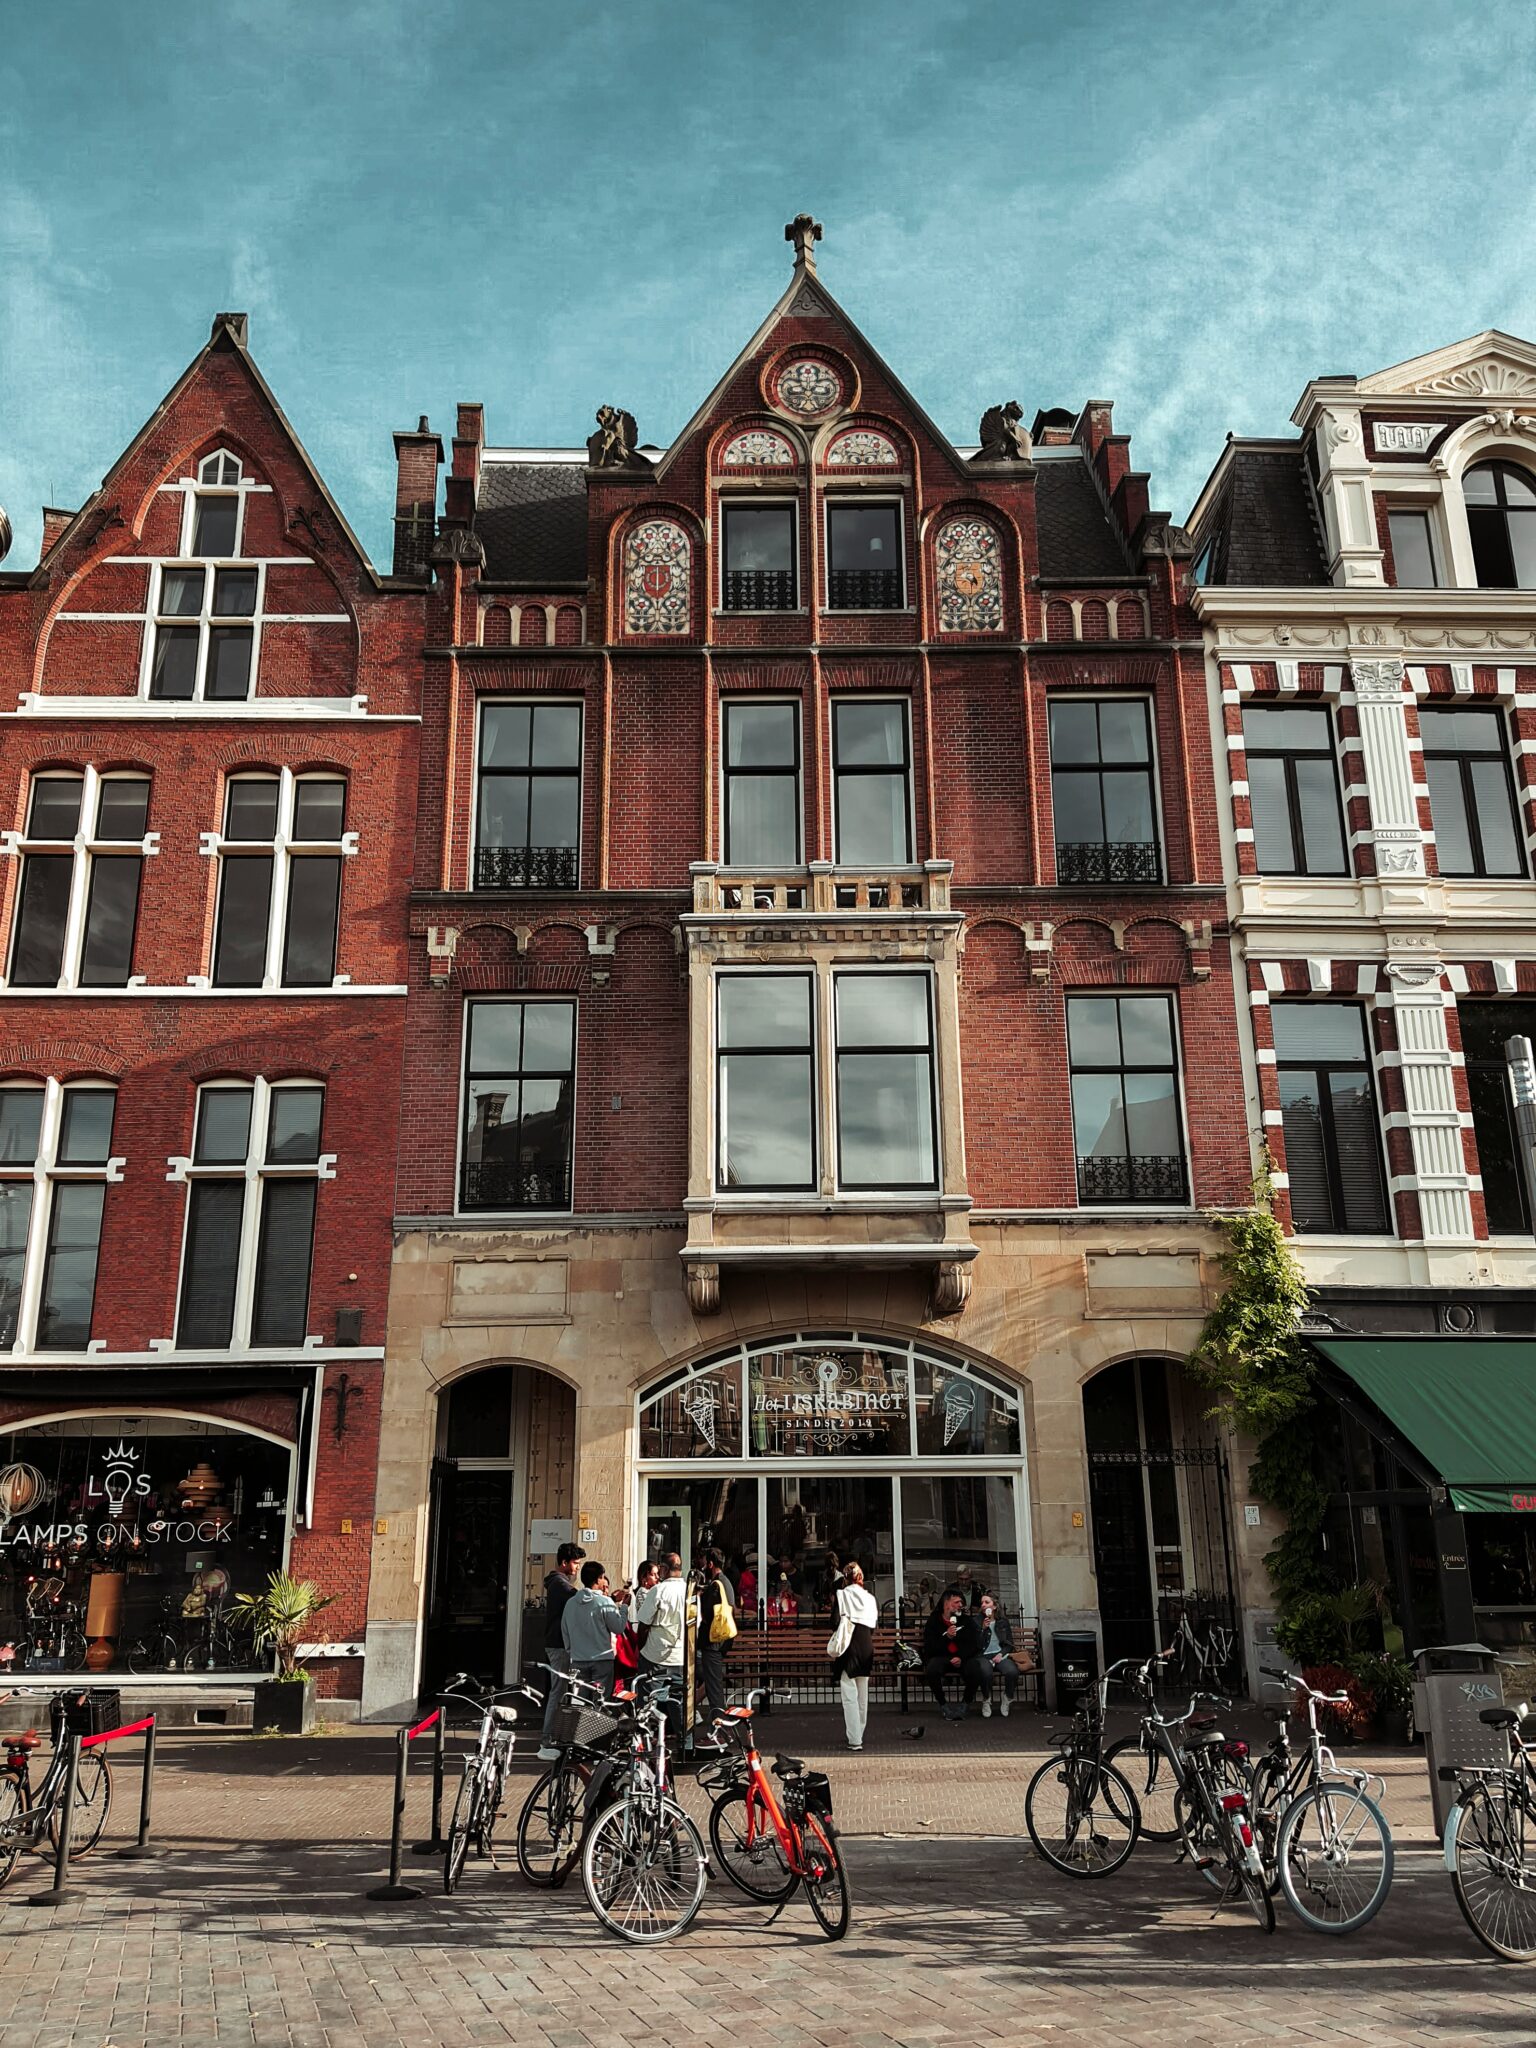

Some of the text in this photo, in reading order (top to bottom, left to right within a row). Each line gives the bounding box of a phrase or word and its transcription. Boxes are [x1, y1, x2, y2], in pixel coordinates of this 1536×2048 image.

[753, 1394, 778, 1411] Het
[786, 1420, 830, 1428] SINDS
[0, 1521, 233, 1545] LAMPS ON STOCK
[585, 1531, 595, 1541] 31
